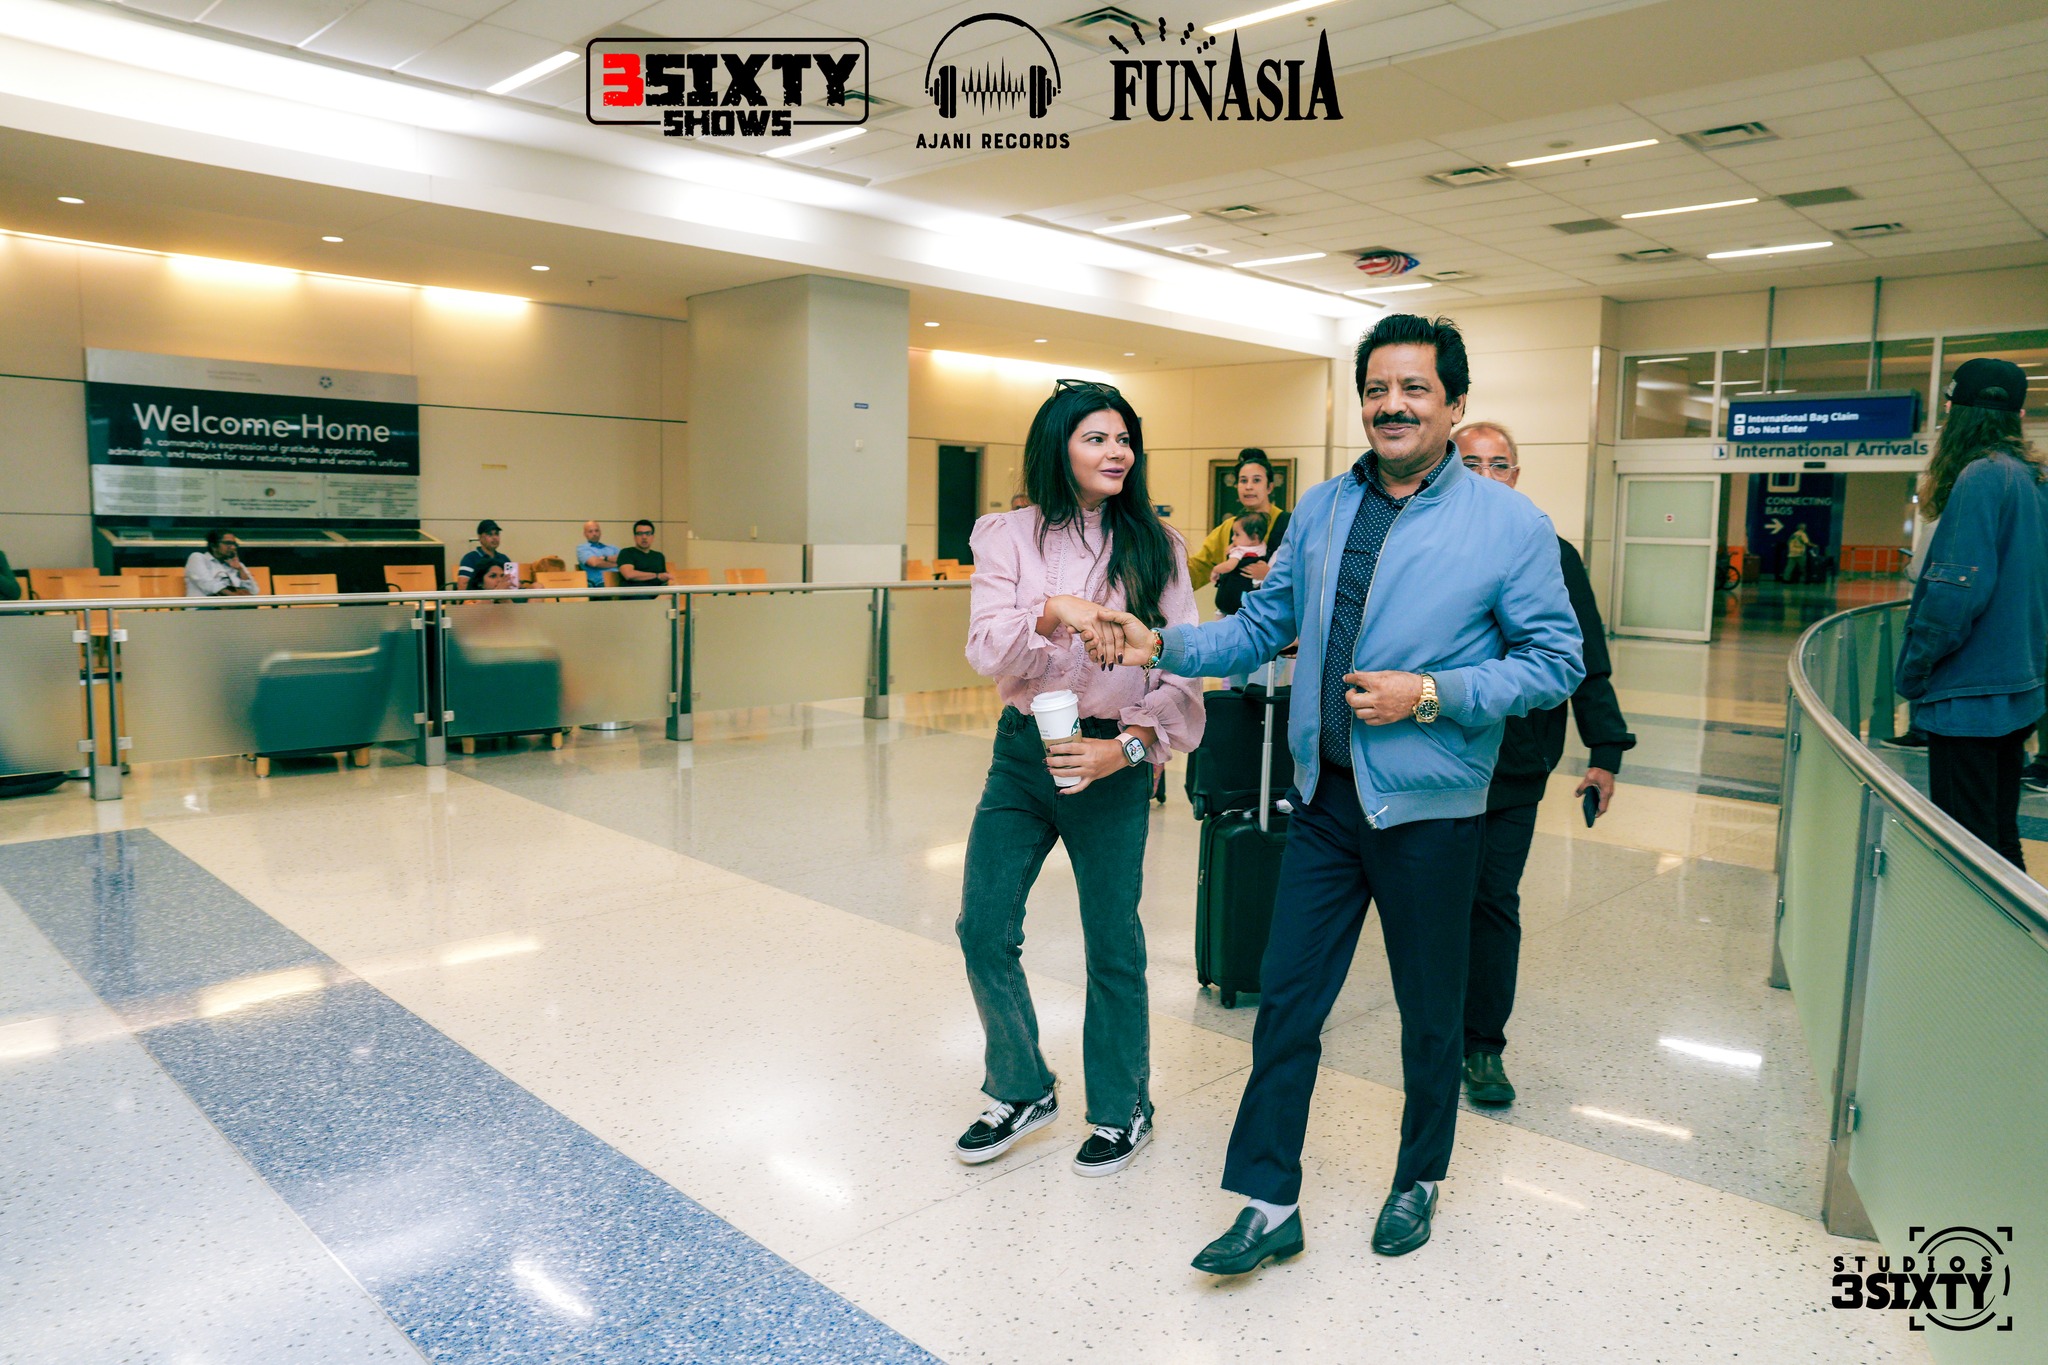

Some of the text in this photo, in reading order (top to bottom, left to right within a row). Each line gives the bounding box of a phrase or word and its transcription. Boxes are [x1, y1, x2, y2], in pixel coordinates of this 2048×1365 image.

[132, 402, 391, 443] Welcome Home
[1747, 411, 1860, 425] International Bag Claim
[1746, 424, 1809, 435] Do Not Enter
[143, 437, 378, 457] A community's expression of gratitude, appreciation,
[1735, 440, 1929, 458] International Arrivals
[165, 450, 185, 459] and
[186, 451, 222, 462] respect
[223, 452, 238, 461] for
[239, 454, 255, 462] our
[256, 455, 298, 466] returning
[298, 457, 318, 465] men
[319, 457, 336, 466] and
[337, 458, 368, 467] women
[369, 458, 377, 466] in
[377, 458, 410, 468] uniform
[1764, 496, 1833, 507] CONNECTING
[1764, 506, 1794, 516] BAGS
